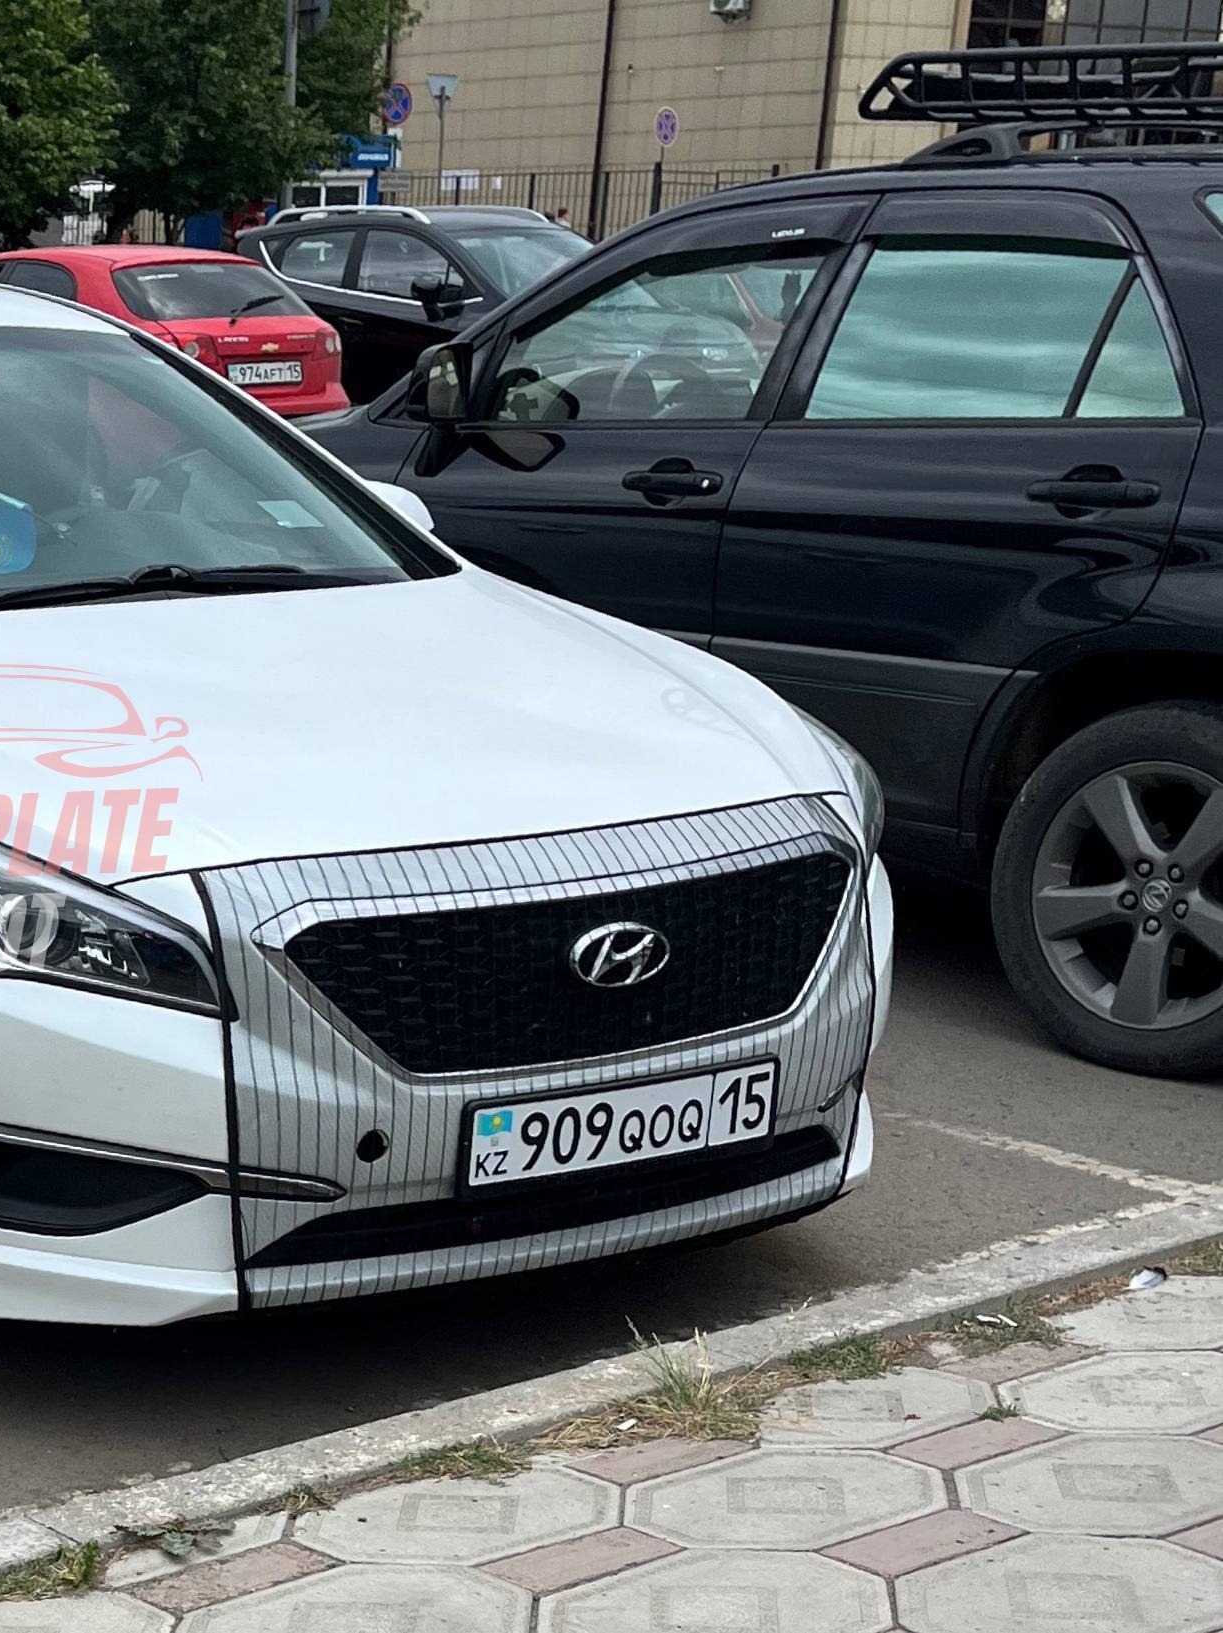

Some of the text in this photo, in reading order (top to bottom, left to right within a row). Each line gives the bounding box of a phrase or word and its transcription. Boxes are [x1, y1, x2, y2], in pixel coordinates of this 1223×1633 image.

[239, 365, 283, 381] 974AFT
[287, 364, 301, 379] 15
[520, 1071, 771, 1172] 909QOQ 15
[474, 1150, 509, 1178] KZ
